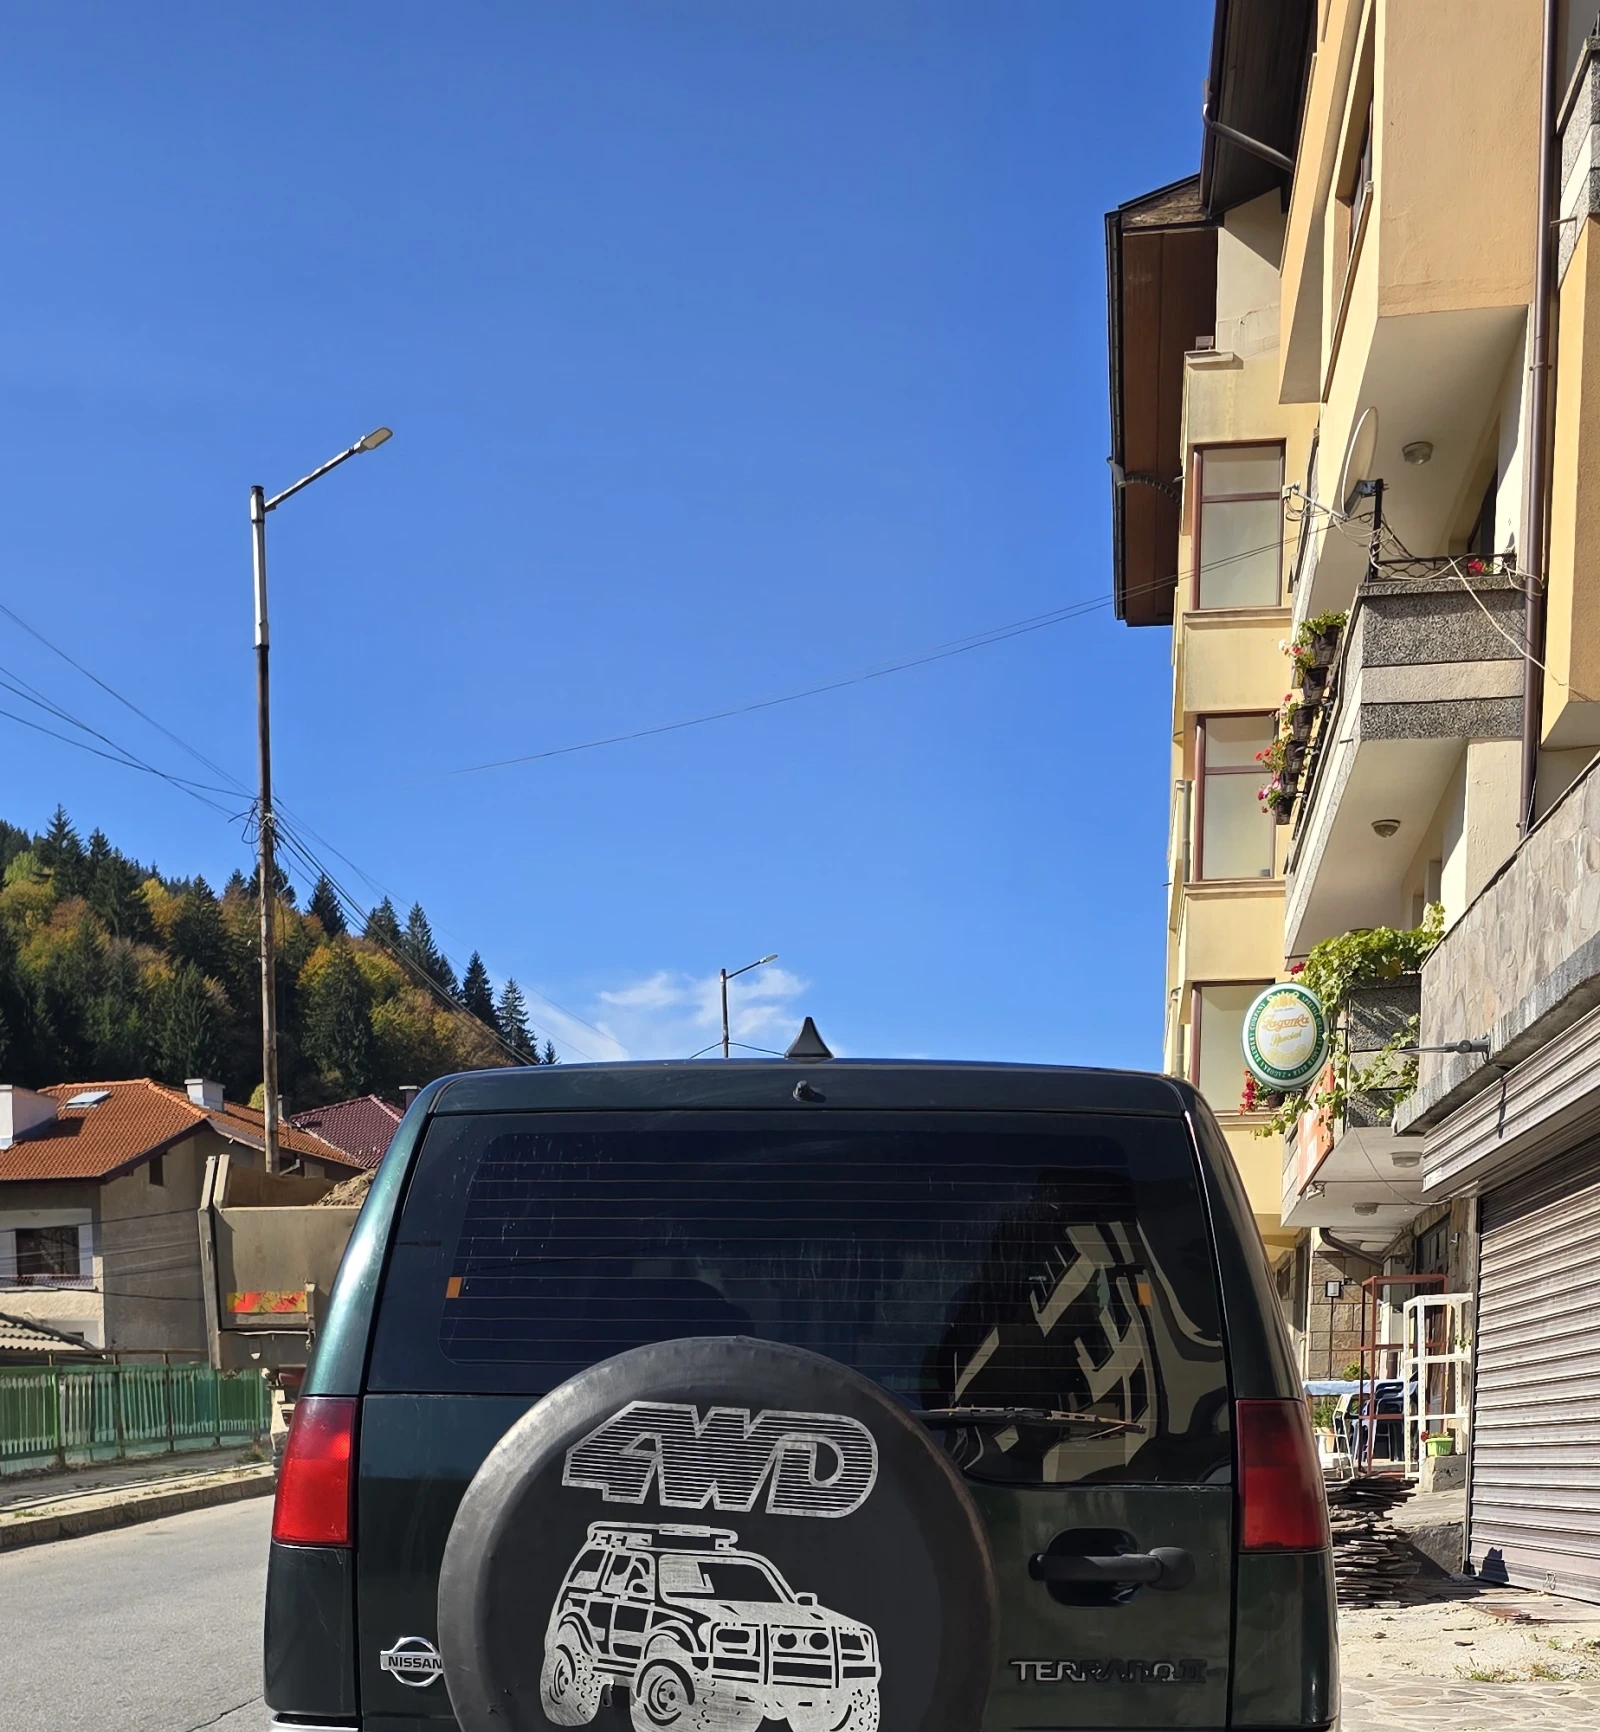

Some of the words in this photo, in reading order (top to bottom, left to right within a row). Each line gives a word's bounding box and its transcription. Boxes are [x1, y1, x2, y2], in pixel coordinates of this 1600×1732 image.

[1262, 1014, 1310, 1032] Zagorka
[1270, 1029, 1303, 1047] Special
[562, 1401, 878, 1519] 4WD
[388, 1656, 442, 1669] NISSAN
